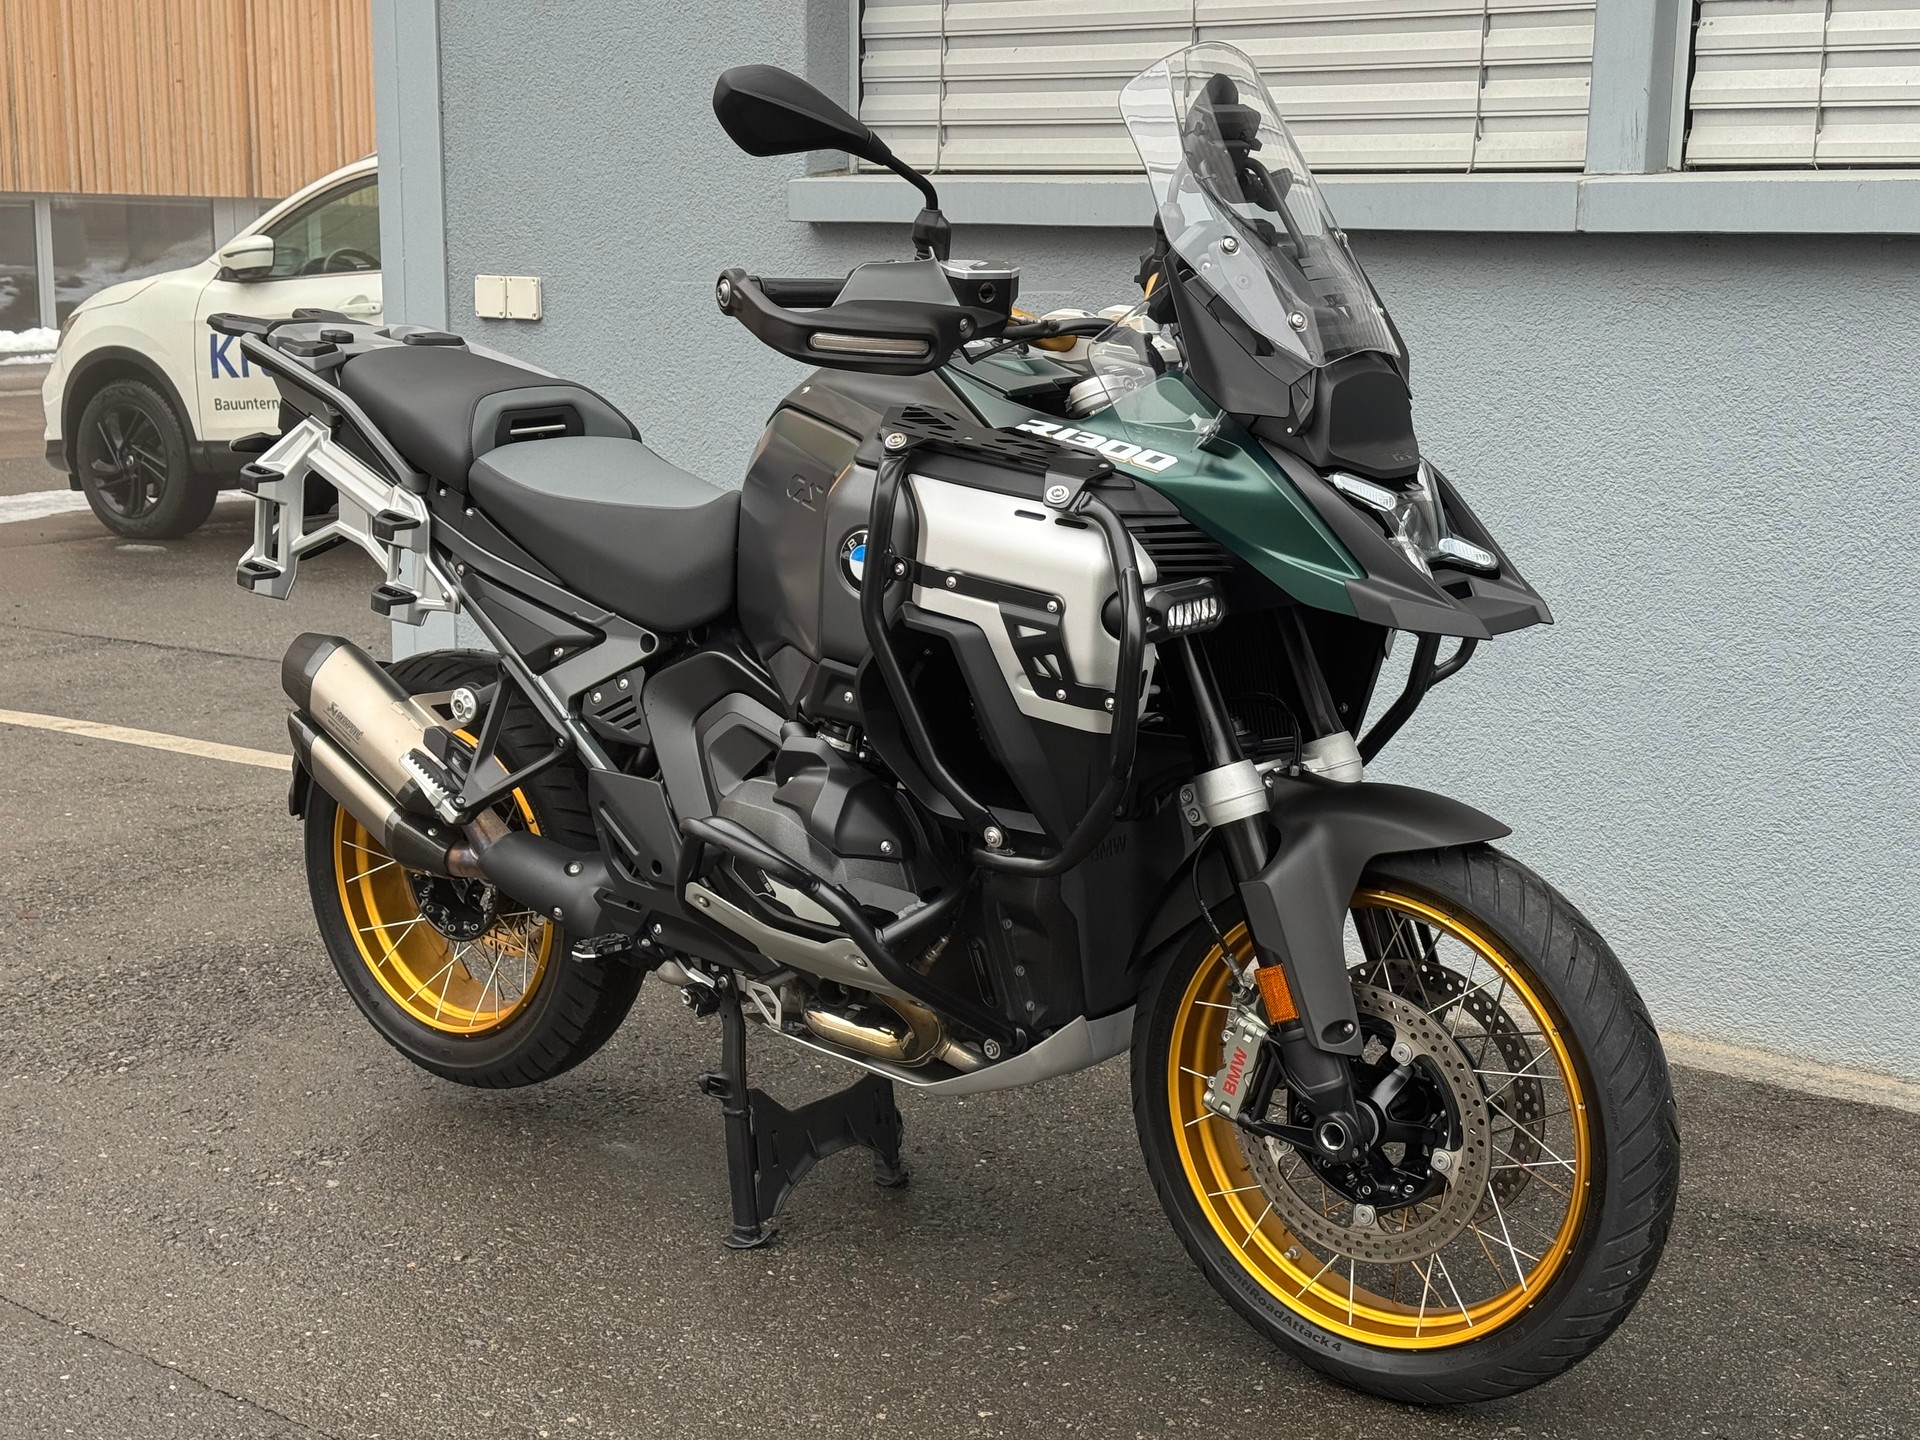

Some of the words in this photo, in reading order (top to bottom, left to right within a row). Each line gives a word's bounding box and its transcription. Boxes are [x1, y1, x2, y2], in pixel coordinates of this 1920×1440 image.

[1015, 419, 1179, 473] R1300
[1222, 1046, 1248, 1096] BMW
[1220, 1256, 1331, 1347] ContiRoadAttack
[1332, 1340, 1342, 1352] 4
